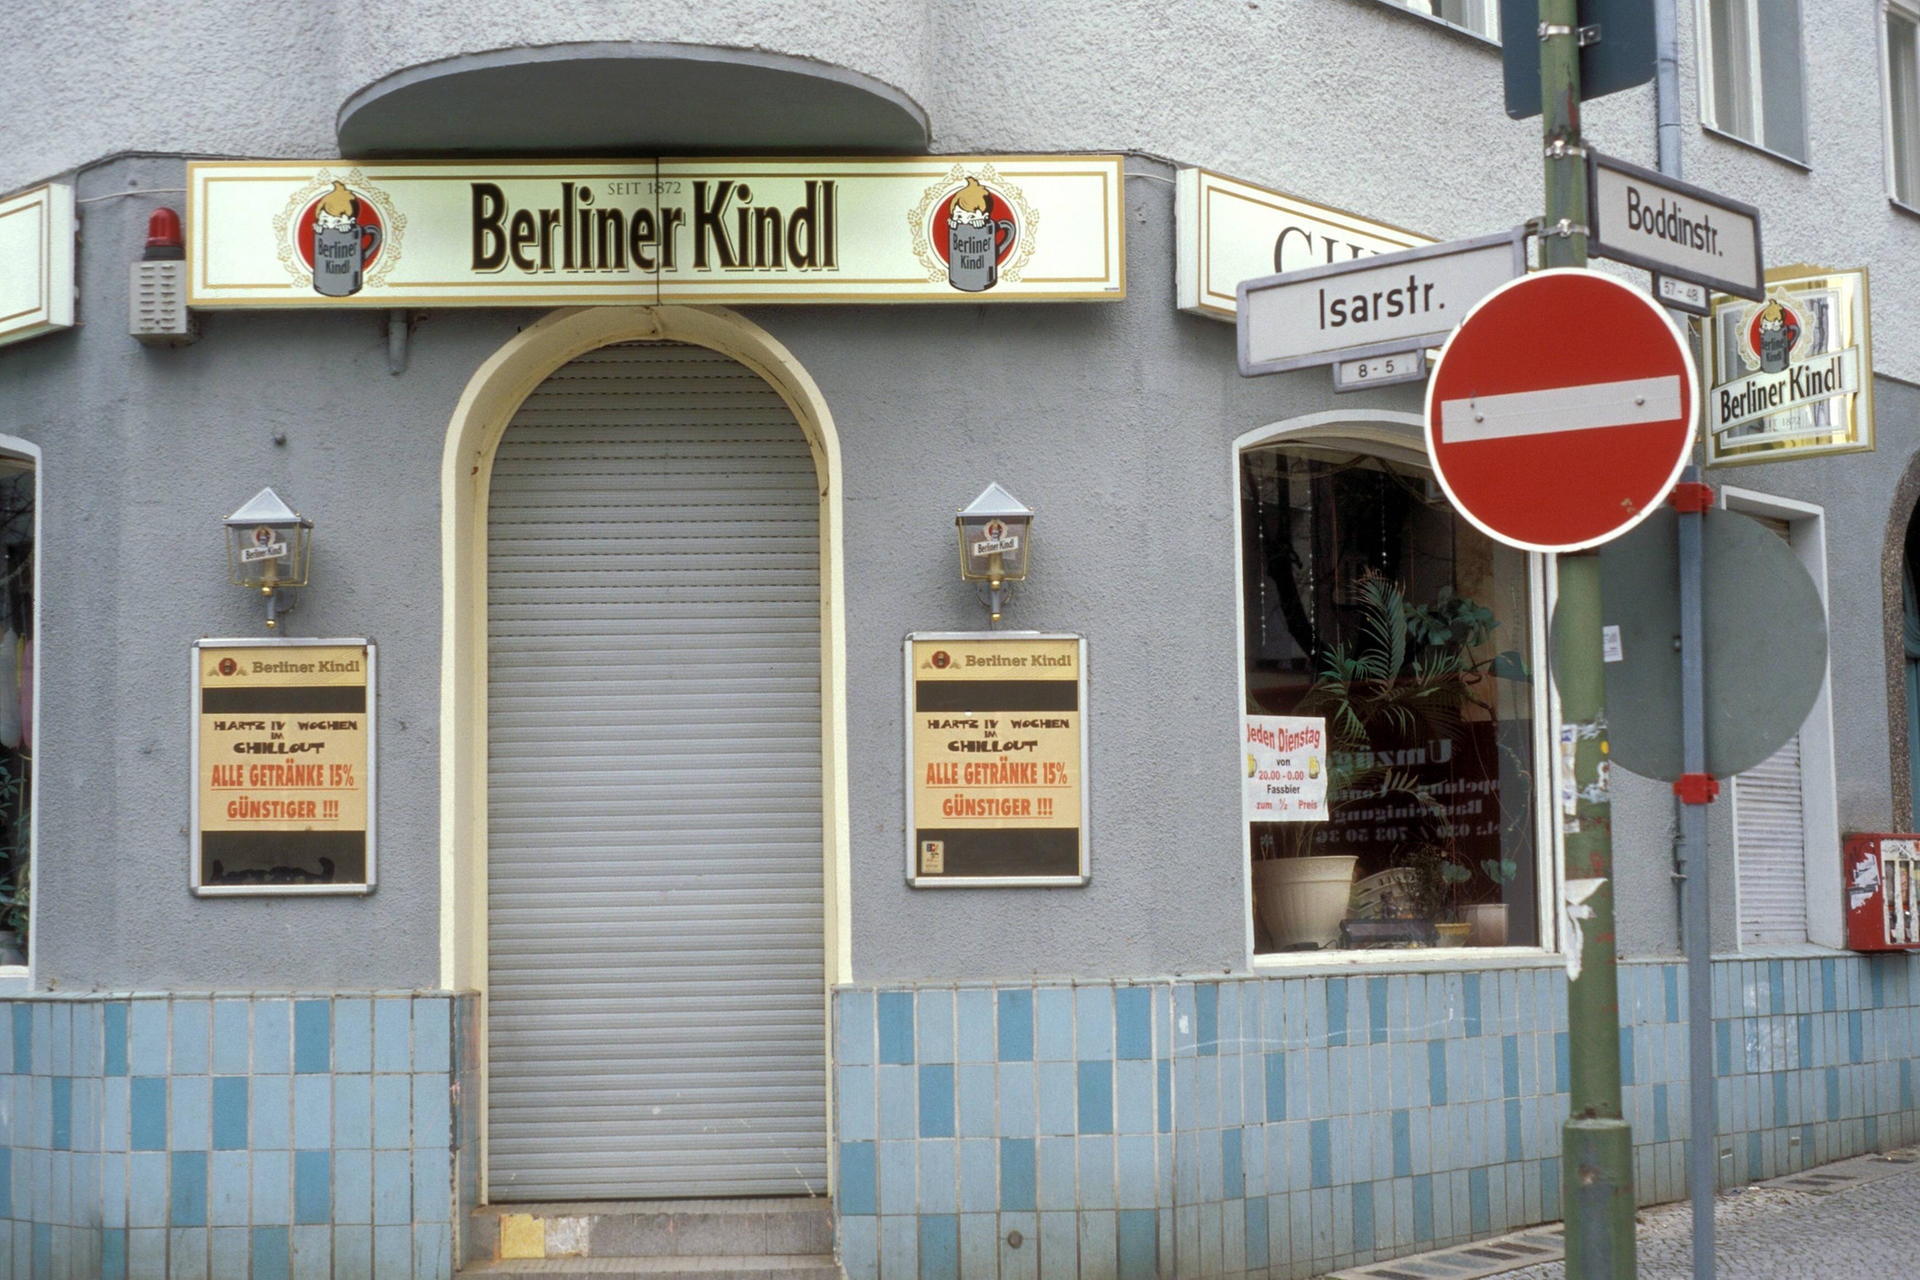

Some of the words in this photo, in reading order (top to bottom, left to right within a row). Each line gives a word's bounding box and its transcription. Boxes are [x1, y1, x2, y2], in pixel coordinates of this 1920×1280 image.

[607, 182, 641, 195] SEIT
[648, 181, 682, 194] 1872
[471, 182, 686, 273] Berliner
[692, 180, 839, 271] Kindl
[1627, 186, 1723, 257] Boddinstr.
[318, 238, 358, 258] Berliner
[953, 233, 992, 254] Berliner
[325, 260, 351, 274] Kindl
[960, 255, 985, 270] Kindl
[1319, 275, 1445, 329] Isarstr.
[1720, 380, 1786, 425] Berliner
[1789, 356, 1842, 401] Kindl
[252, 661, 315, 674] Berliner
[318, 660, 360, 673] Kindl
[965, 655, 1027, 667] Berliner
[1030, 654, 1071, 667] Kindl
[214, 721, 265, 730] HARTZ
[271, 721, 285, 730] IV
[297, 720, 358, 730] WOCHEN
[928, 719, 979, 729] HARTZ
[984, 719, 999, 729] IV
[1010, 719, 1070, 729] WOCHEN
[270, 732, 284, 740] IM
[1278, 726, 1321, 752] Dienstag
[233, 742, 325, 754] CHILLOUT
[947, 740, 1038, 753] CHILLOUT
[211, 765, 244, 787] ALLE
[250, 758, 324, 787] GETRÄNKE
[329, 764, 354, 787] 15%
[926, 762, 959, 785] ALLE
[964, 757, 1037, 785] GETRÄNKE
[1042, 762, 1068, 785] 15%
[1267, 784, 1301, 794] Fassbier
[227, 796, 316, 819] GÜNSTIGER
[942, 794, 1031, 817] GÜNSTIGER
[1256, 801, 1273, 810] zum
[1298, 800, 1318, 810] Preis
